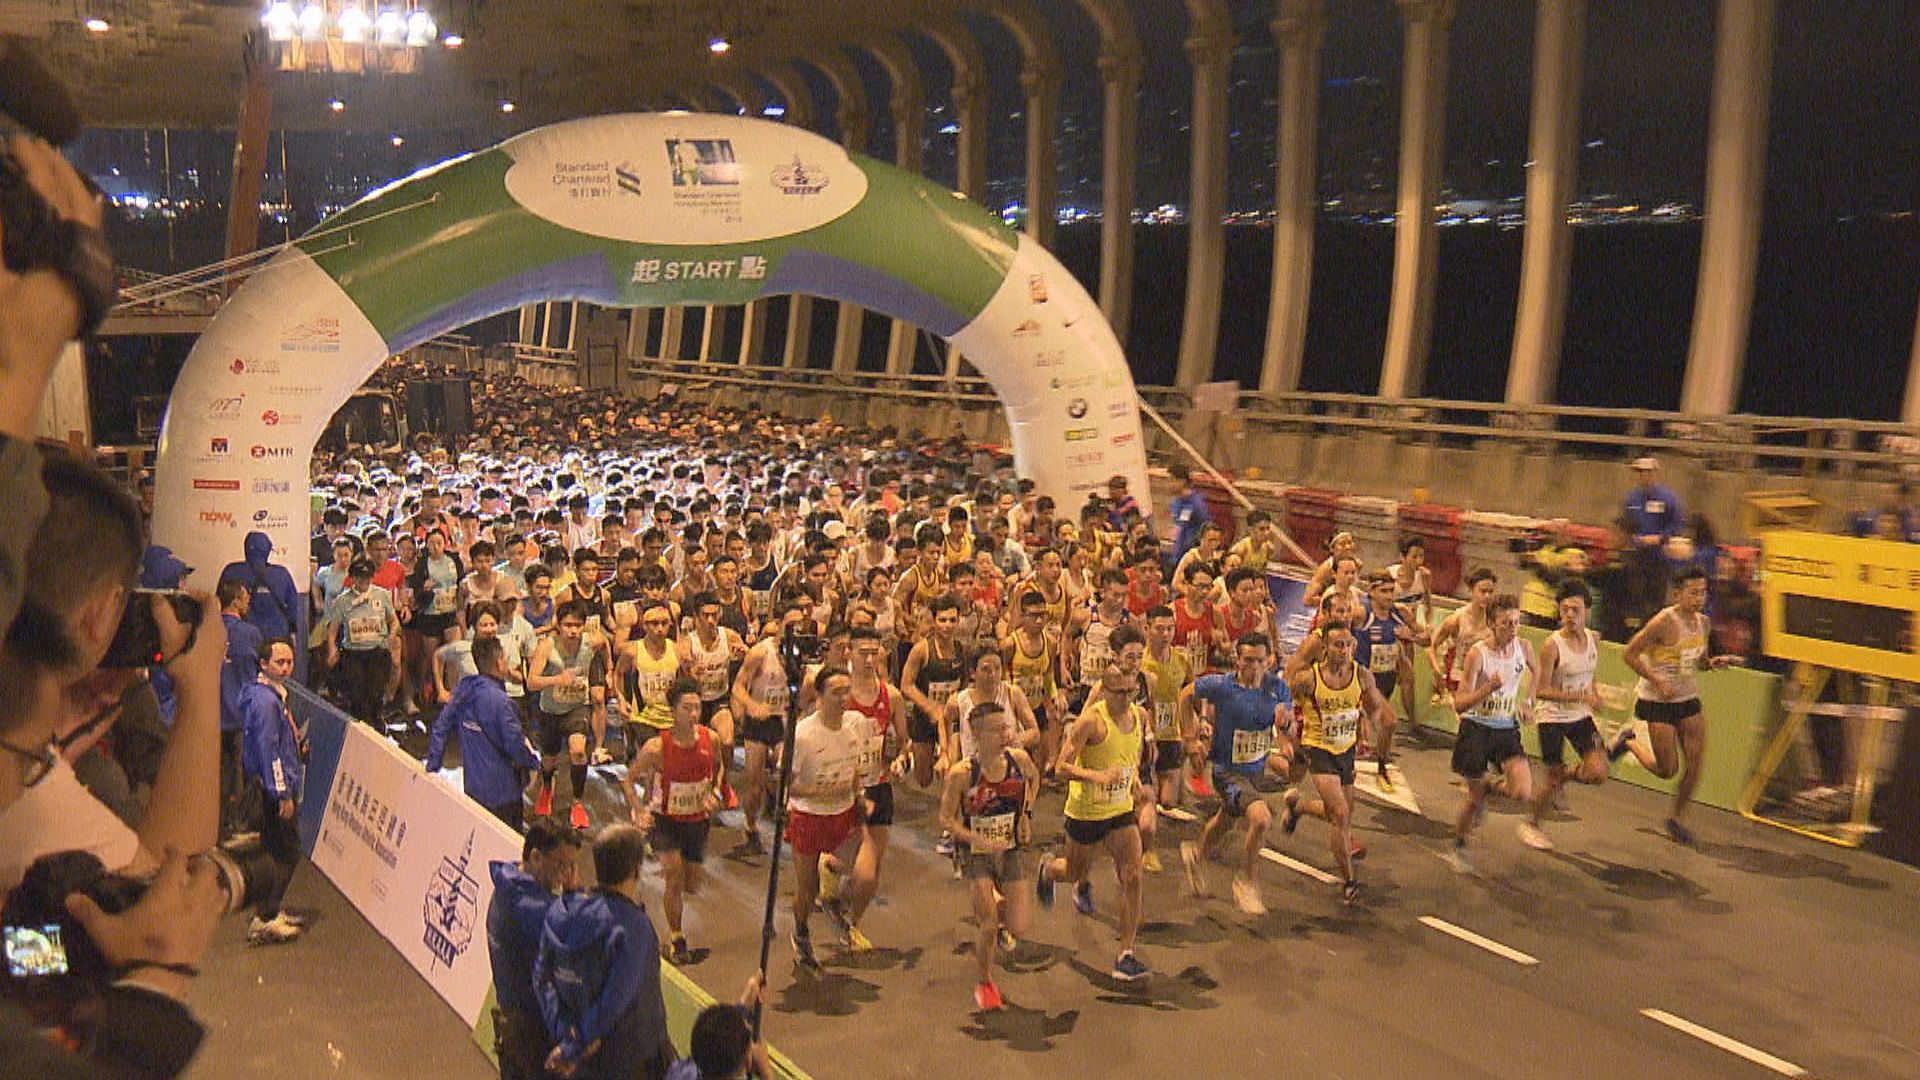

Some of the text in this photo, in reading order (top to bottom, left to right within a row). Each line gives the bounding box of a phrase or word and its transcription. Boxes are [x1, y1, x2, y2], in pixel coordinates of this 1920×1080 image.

[555, 161, 609, 173] Standard
[552, 174, 611, 184] Chartered
[632, 255, 768, 283] 起 START 點
[268, 448, 294, 457] MTR
